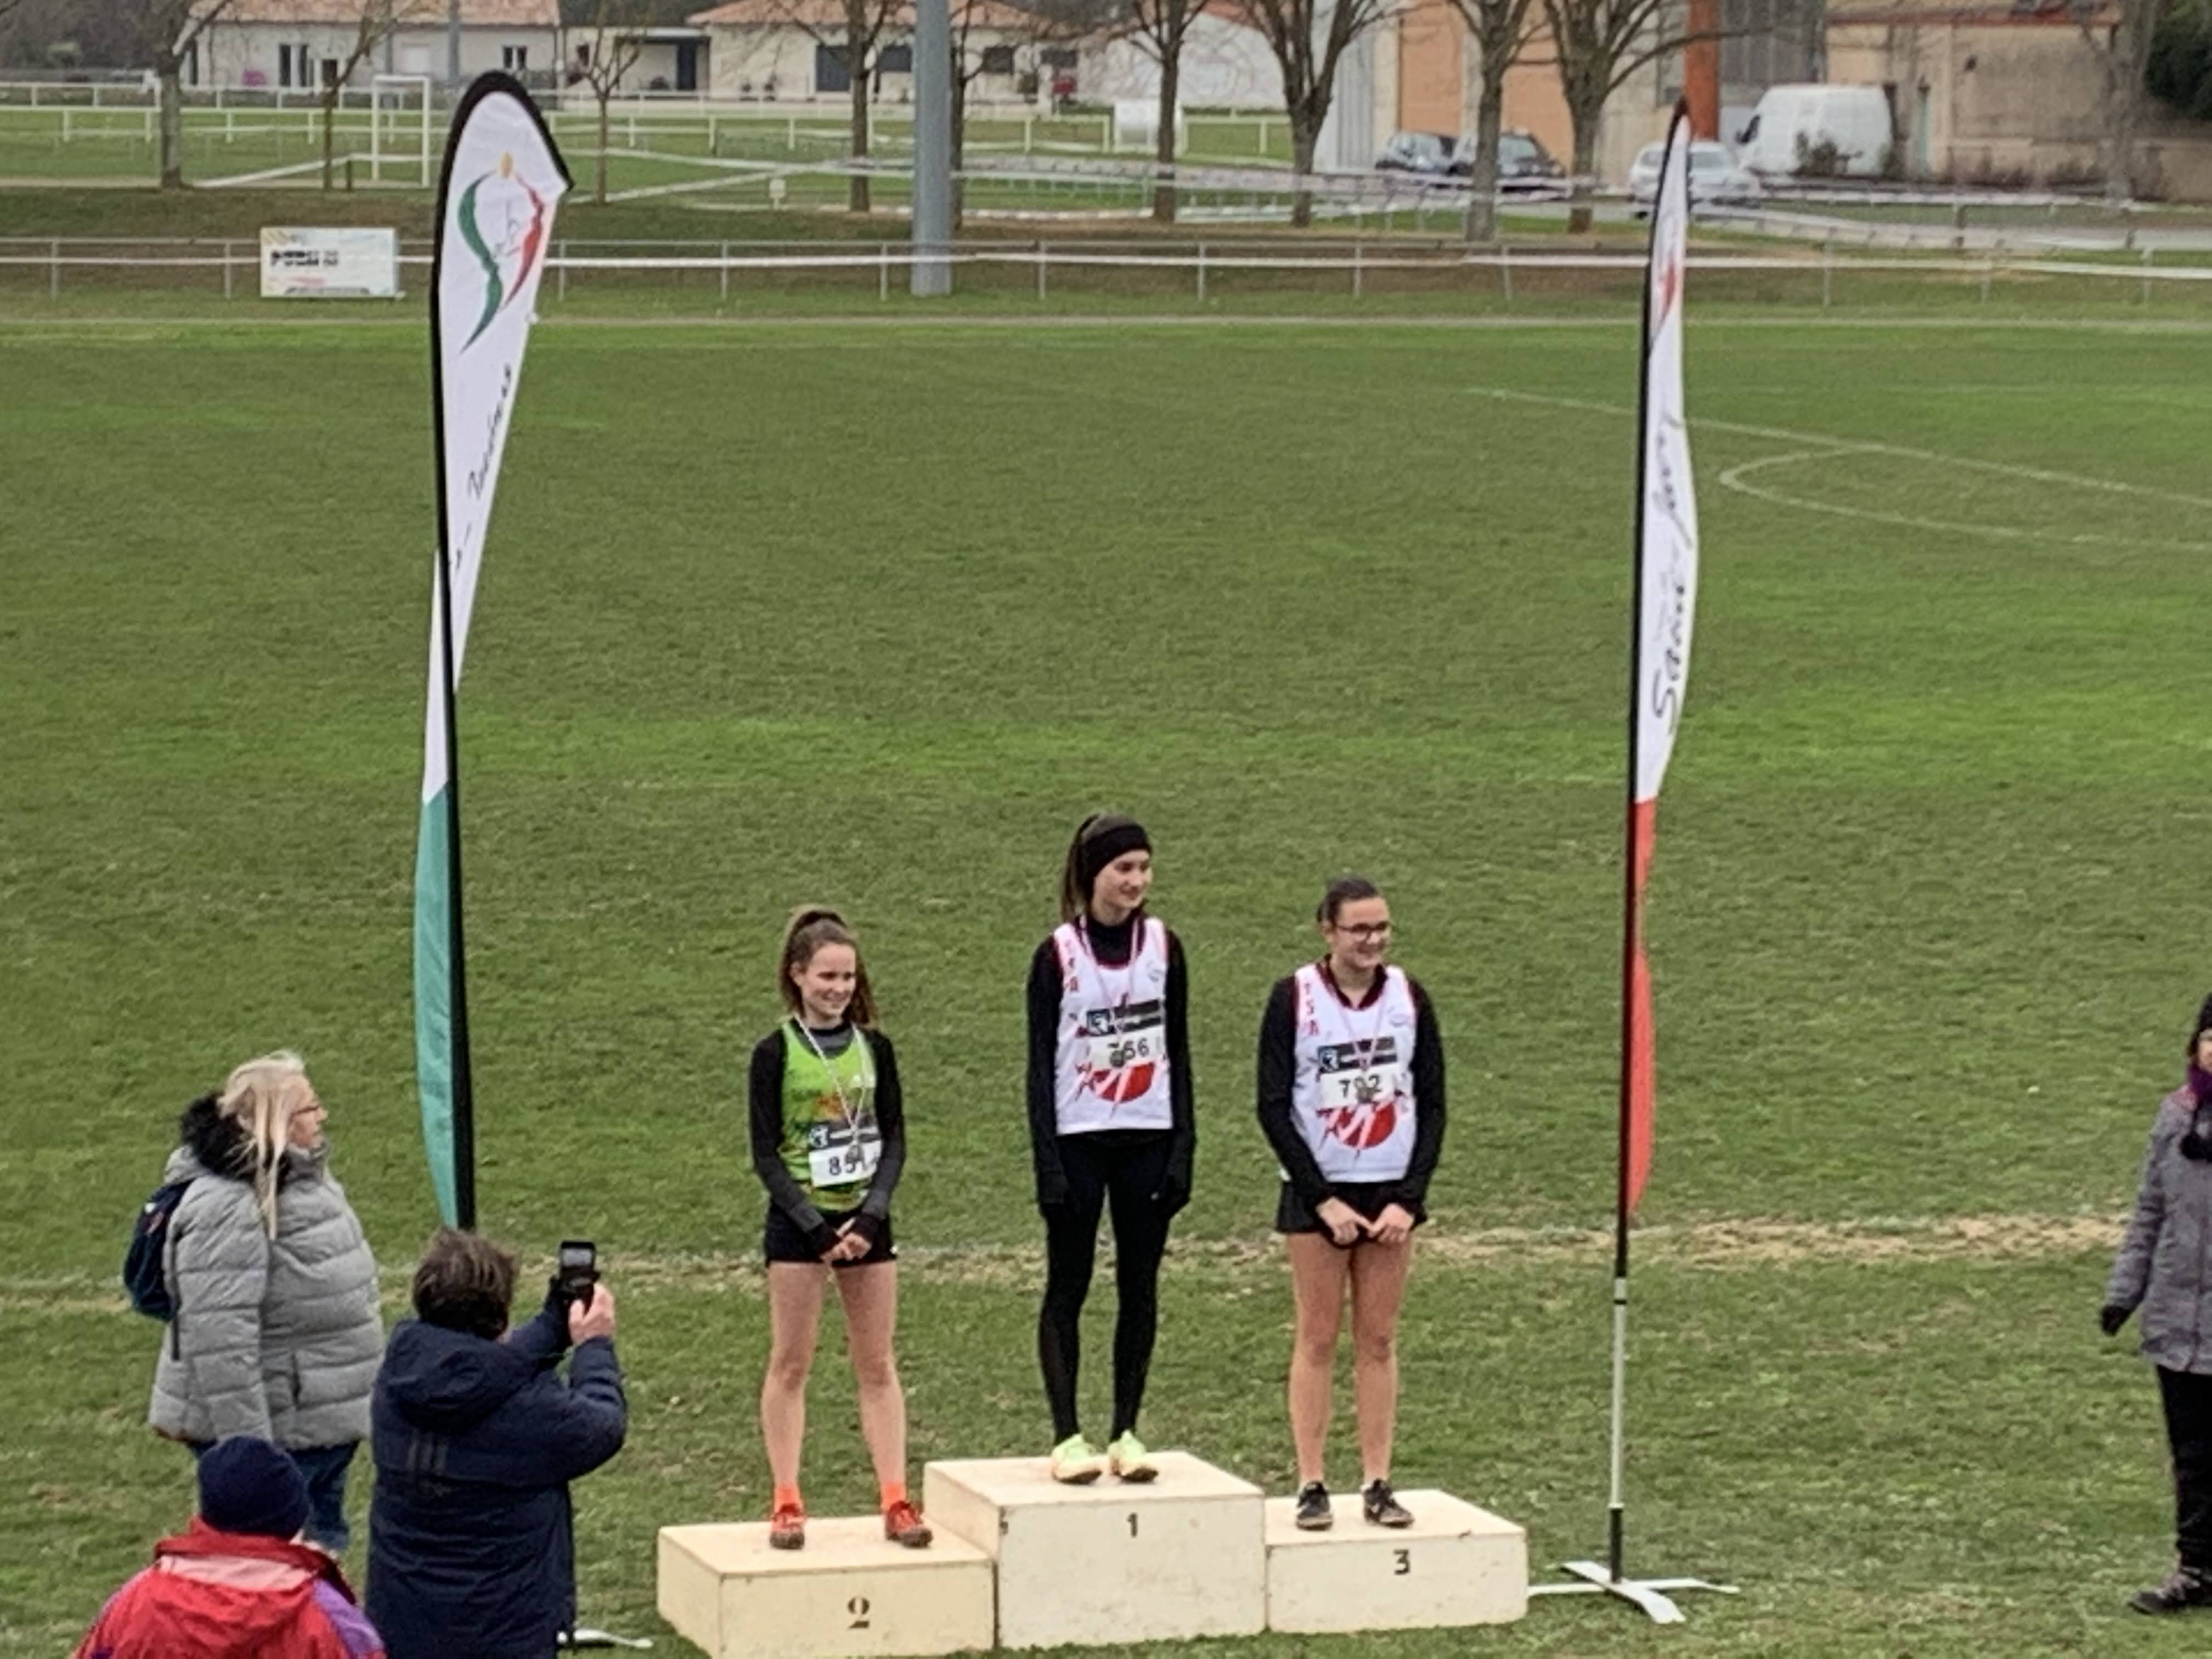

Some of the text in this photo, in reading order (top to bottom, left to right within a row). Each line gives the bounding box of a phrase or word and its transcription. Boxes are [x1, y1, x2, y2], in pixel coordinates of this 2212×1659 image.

[1126, 1512, 1138, 1538] 1
[1393, 1549, 1410, 1575] 3
[847, 1594, 870, 1629] 2
